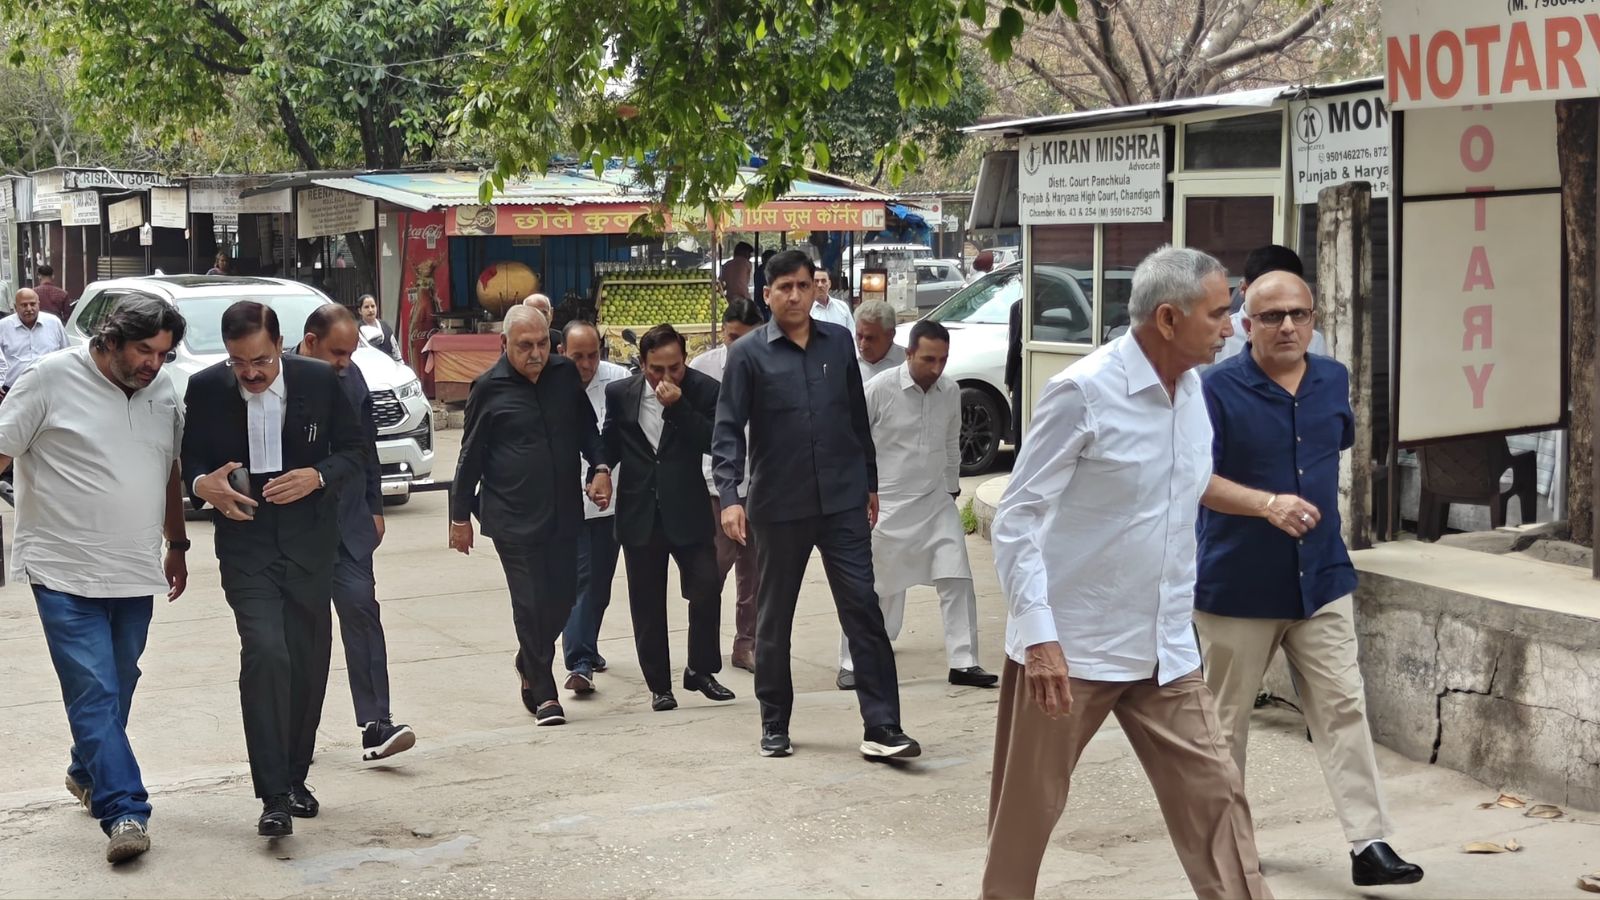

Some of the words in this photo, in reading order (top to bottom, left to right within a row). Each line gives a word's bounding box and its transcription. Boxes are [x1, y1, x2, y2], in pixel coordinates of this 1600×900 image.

[1042, 138, 1091, 165] KIRAN
[1096, 133, 1160, 163] MISHRA
[1128, 161, 1161, 171] Advocate
[1299, 167, 1337, 184] Punjab
[1342, 166, 1350, 179] &
[1069, 175, 1089, 188] Court
[1091, 174, 1131, 187] Panchkula
[1022, 192, 1043, 206] Punjab
[1045, 192, 1050, 203] &
[1052, 191, 1079, 205] Haryana
[1080, 190, 1096, 204] High
[1098, 189, 1118, 204] Court,
[1120, 188, 1161, 202] Chandigarh
[511, 207, 575, 229] छोले
[782, 208, 812, 229] जूस
[816, 203, 860, 226] कॉर्नर
[1029, 207, 1056, 218] Chamber
[1057, 208, 1067, 217] No.
[1085, 207, 1097, 216] 254
